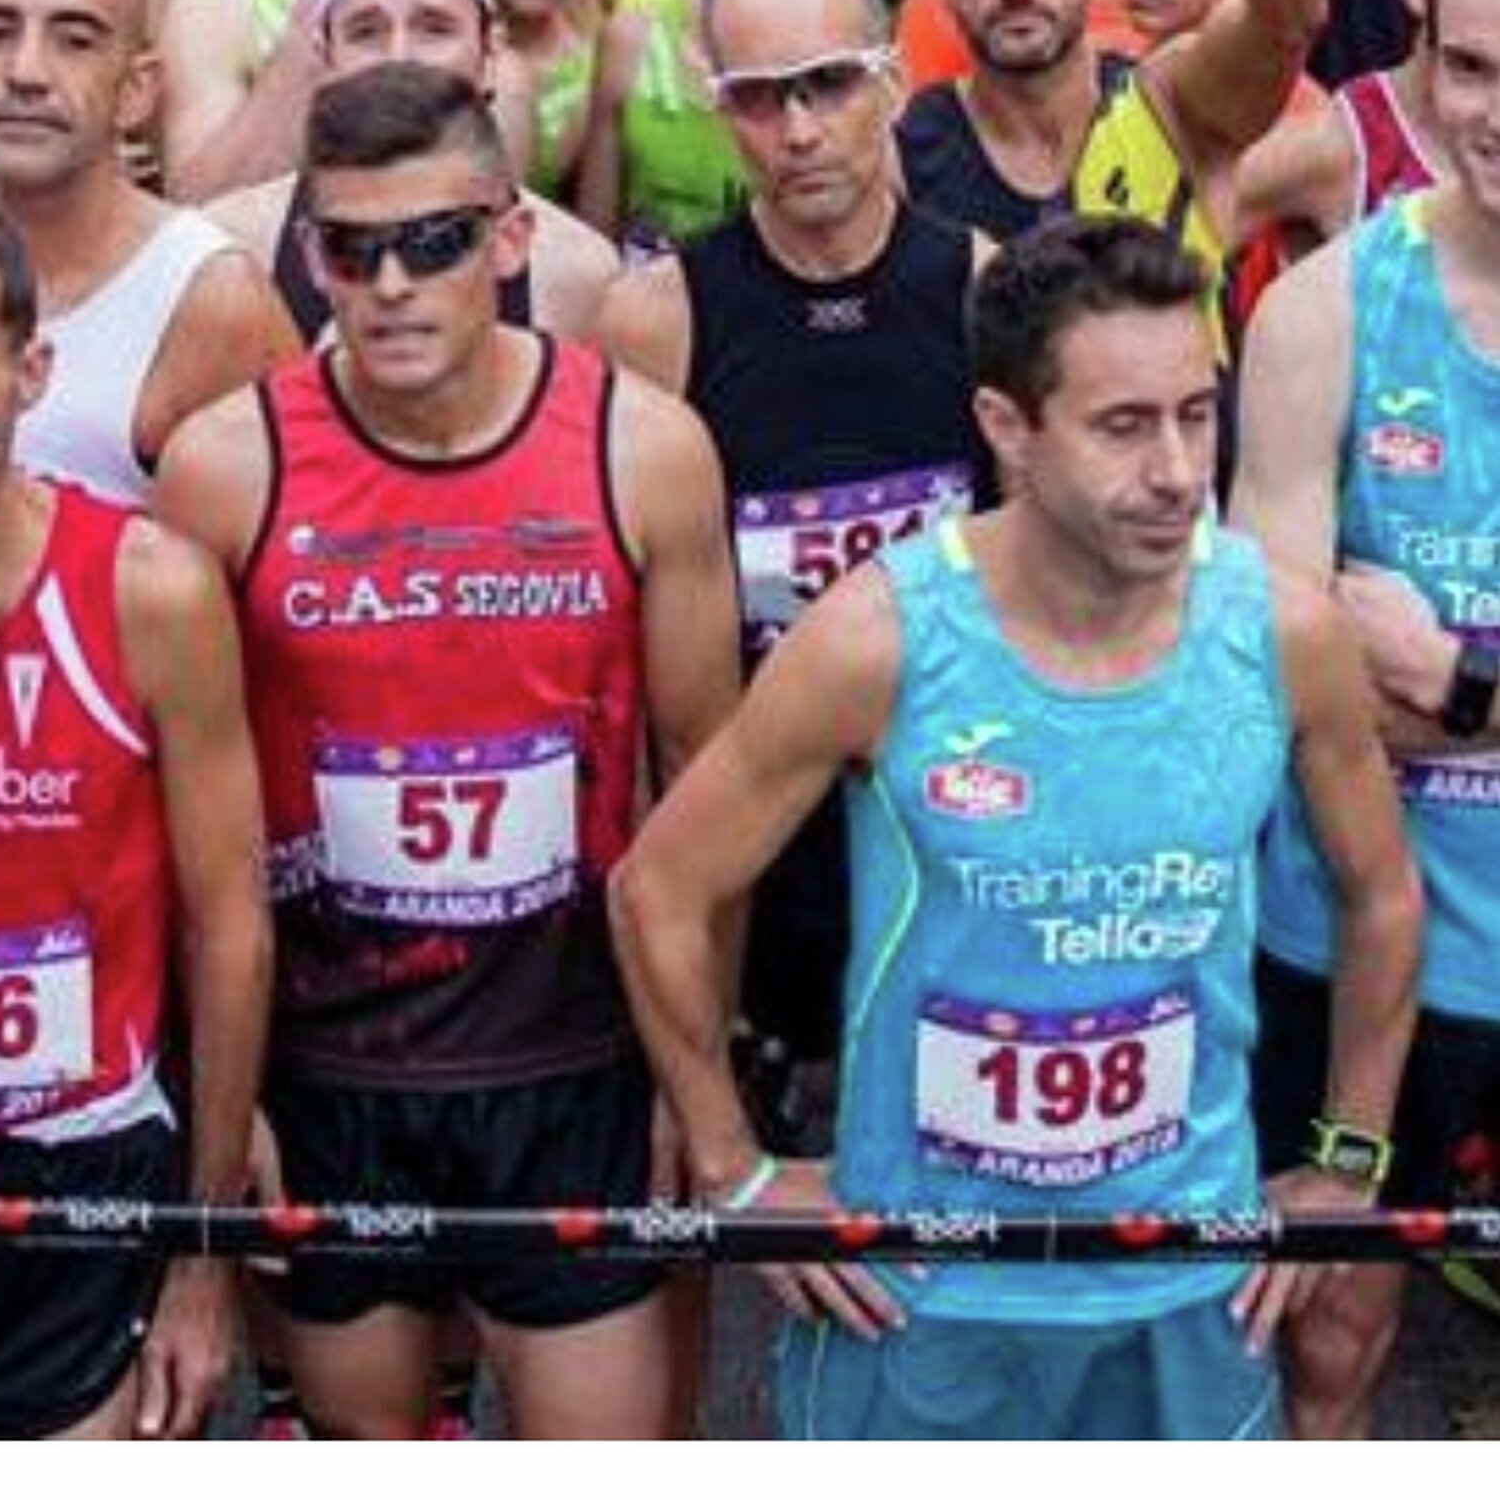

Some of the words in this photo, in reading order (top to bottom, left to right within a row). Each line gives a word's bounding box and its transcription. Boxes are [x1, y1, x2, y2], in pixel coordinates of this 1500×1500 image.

[455, 569, 608, 618] SEGOVIA
[399, 779, 509, 863] 57
[384, 890, 504, 928] ARANDA
[976, 1040, 1147, 1127] 198
[976, 1146, 1103, 1187] ARANDA
